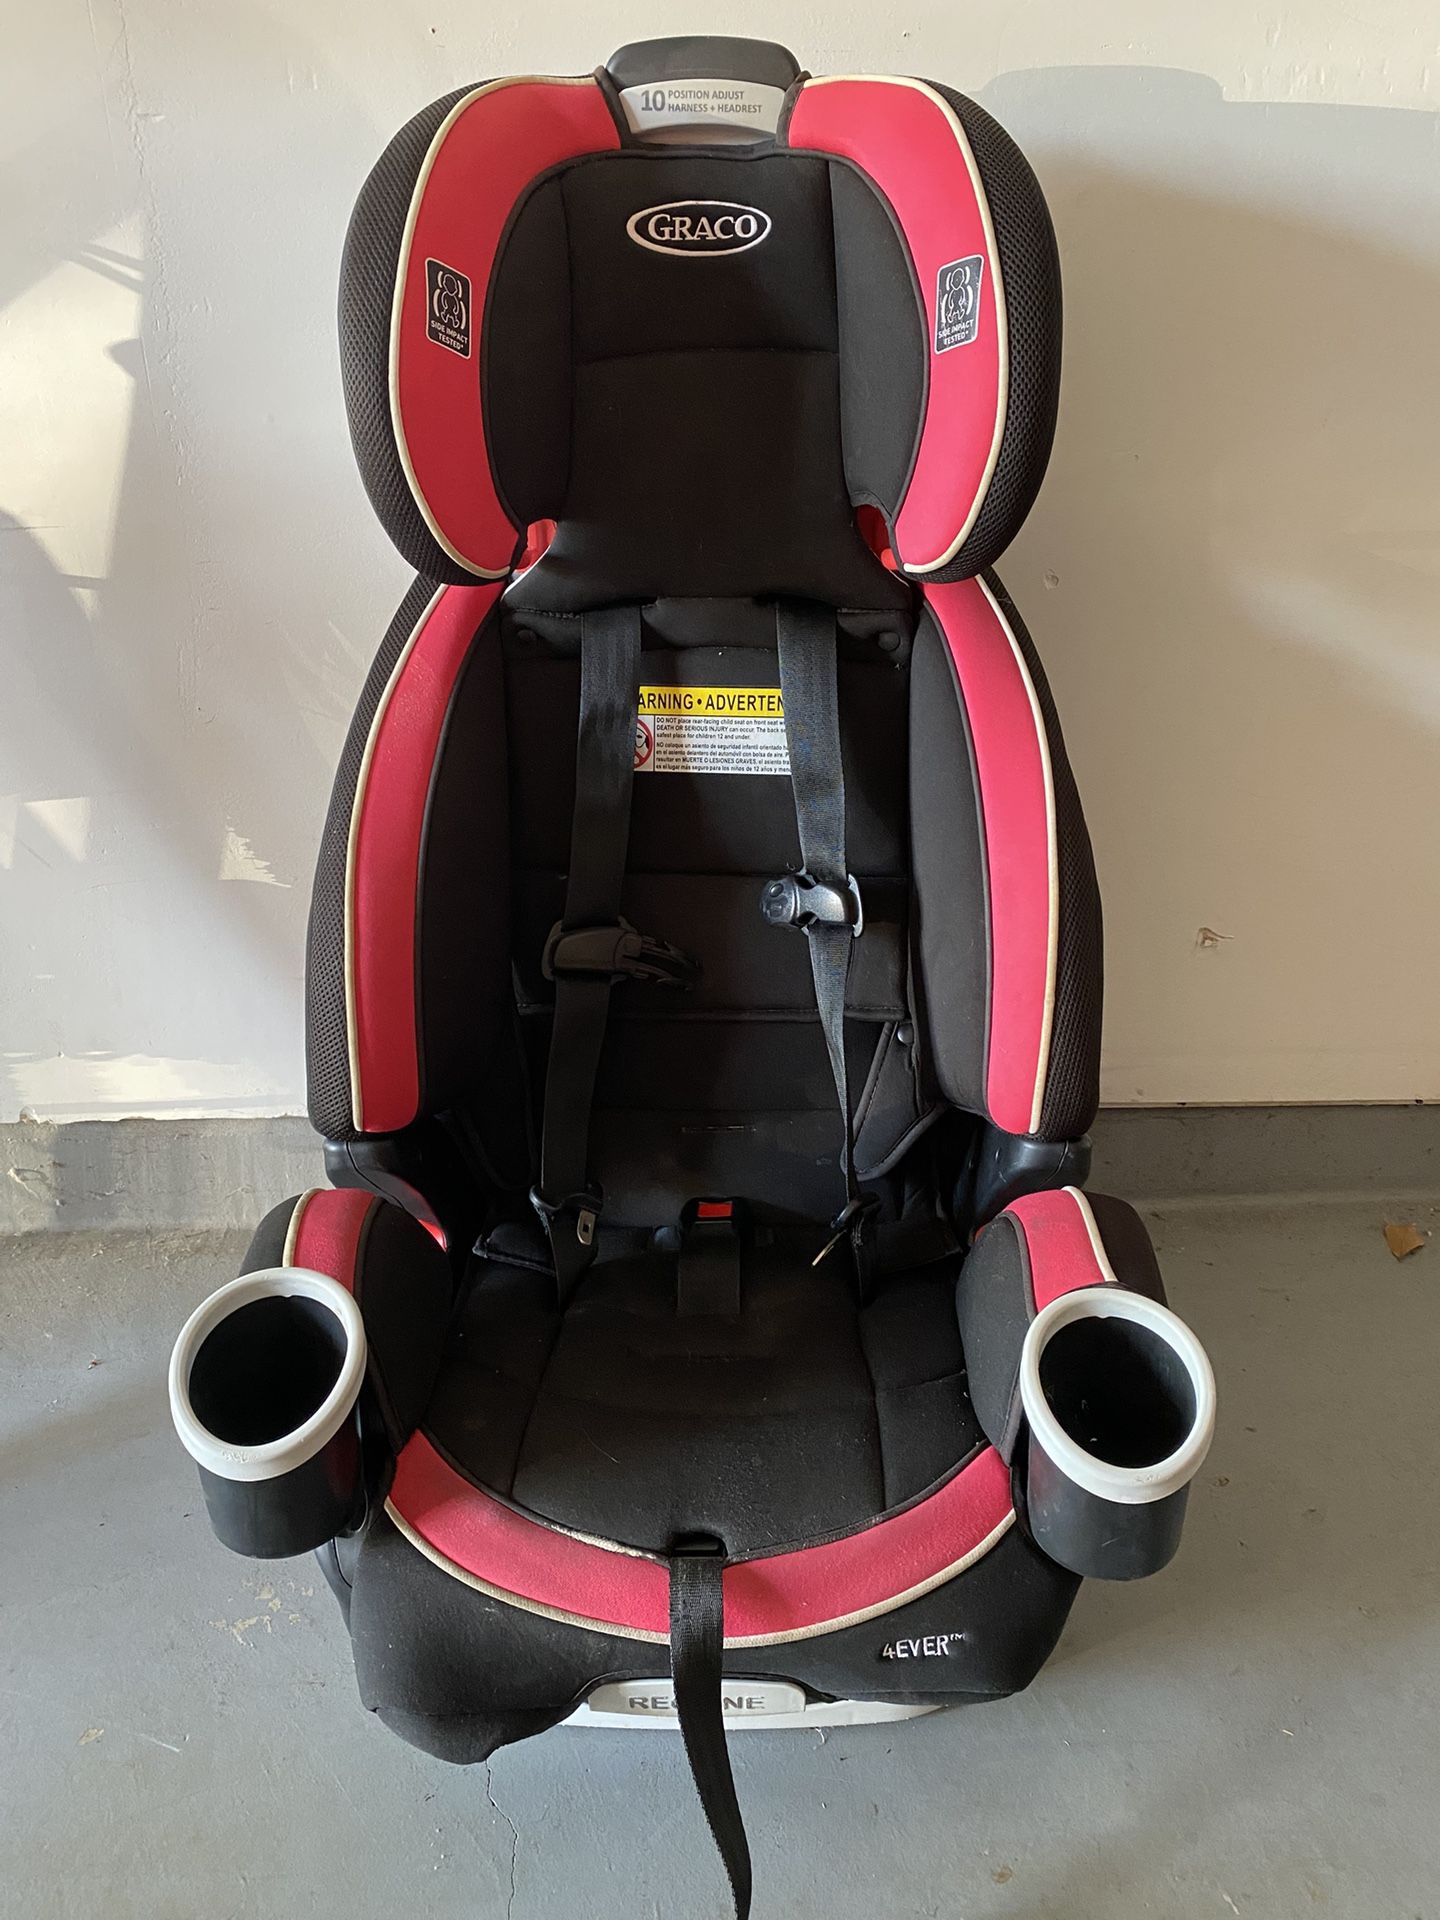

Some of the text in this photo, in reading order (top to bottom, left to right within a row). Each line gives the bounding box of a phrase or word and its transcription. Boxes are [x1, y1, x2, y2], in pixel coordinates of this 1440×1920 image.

[641, 89, 744, 112] 10 POSITION ADJUST
[668, 103, 709, 113] HARNESS
[718, 103, 763, 114] HEADREST
[648, 214, 758, 241] GRACO
[431, 320, 468, 344] SIDE IMPACT
[938, 319, 974, 339] SIDE IMPACT
[638, 693, 784, 711] ARNING ADVERTEN
[629, 1696, 765, 1710] RENE
